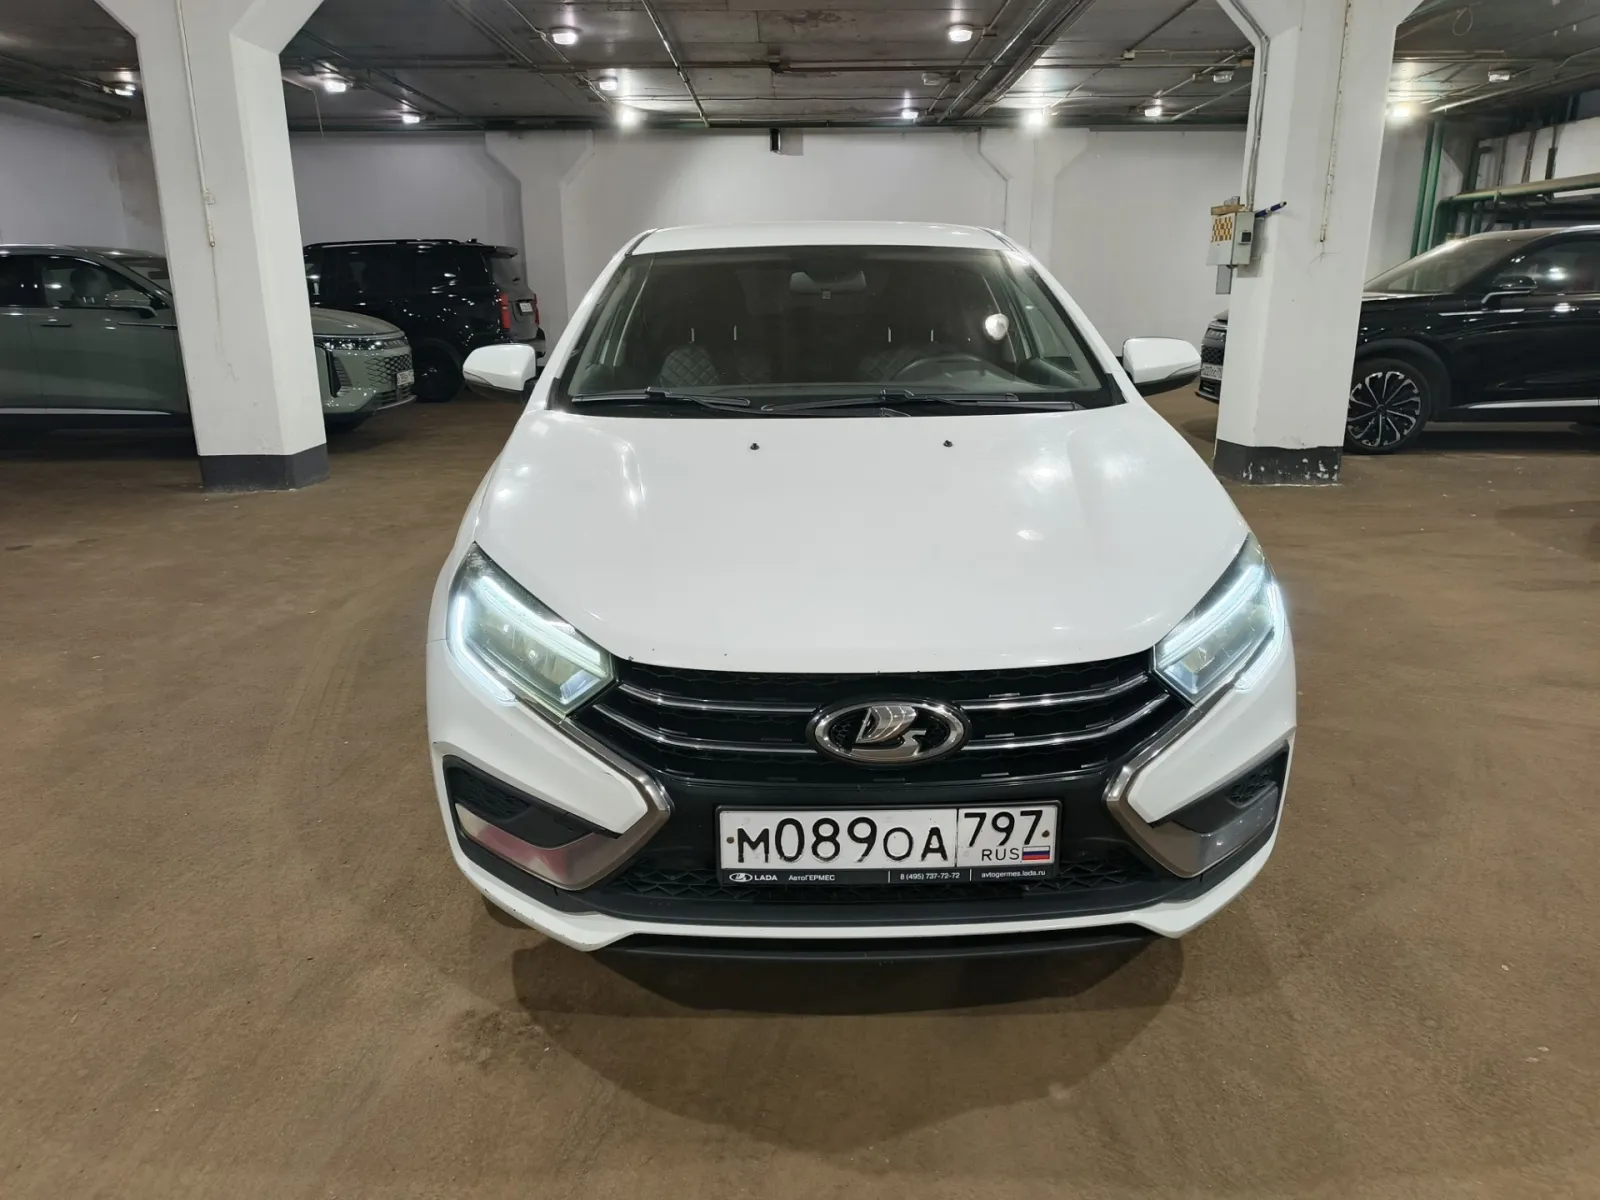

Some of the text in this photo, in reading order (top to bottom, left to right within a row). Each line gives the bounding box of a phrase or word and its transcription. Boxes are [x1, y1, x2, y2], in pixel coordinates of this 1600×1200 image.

[964, 809, 1043, 847] 797
[981, 847, 1020, 861] RUS
[754, 873, 778, 881] LADA
[788, 874, 835, 882] АвтоГЕРМЕС
[906, 873, 925, 881] (495)
[925, 872, 961, 880] 737-72-72
[981, 869, 1046, 878] avtogermes.lada.ru
